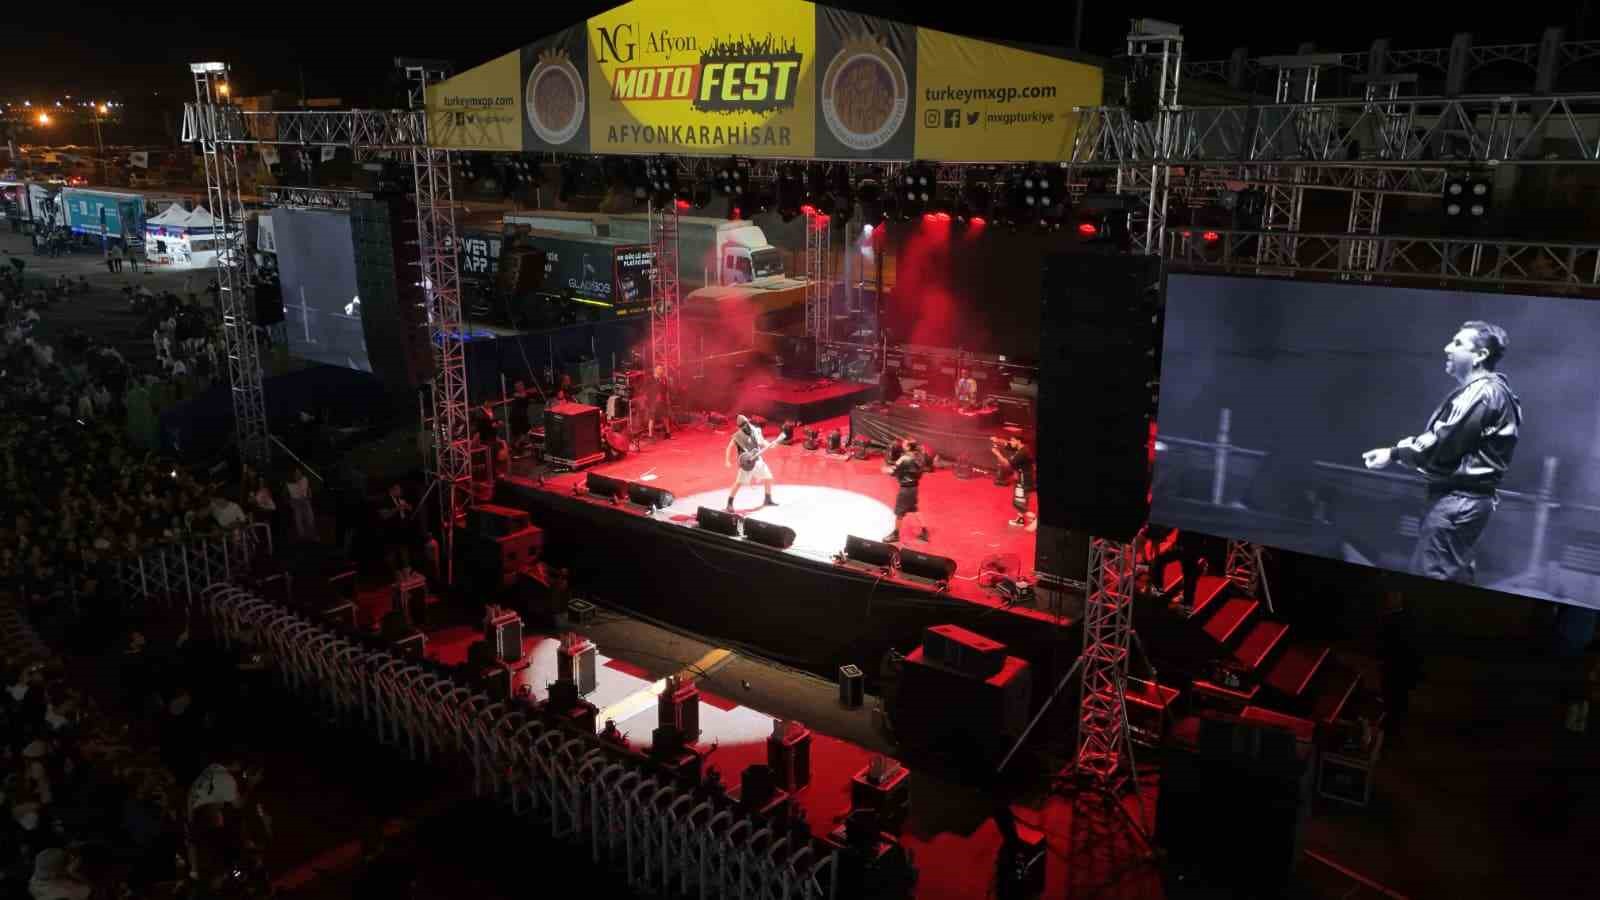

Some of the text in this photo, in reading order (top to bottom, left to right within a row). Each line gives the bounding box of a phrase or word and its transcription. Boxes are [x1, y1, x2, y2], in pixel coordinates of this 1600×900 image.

[596, 23, 697, 63] NG Afyon
[614, 61, 799, 101] MOTO FEST
[925, 84, 1057, 103] turkeymxgp.com
[987, 111, 1055, 125] mxgpturkiye
[607, 121, 791, 147] AFYONKARAHİSAR
